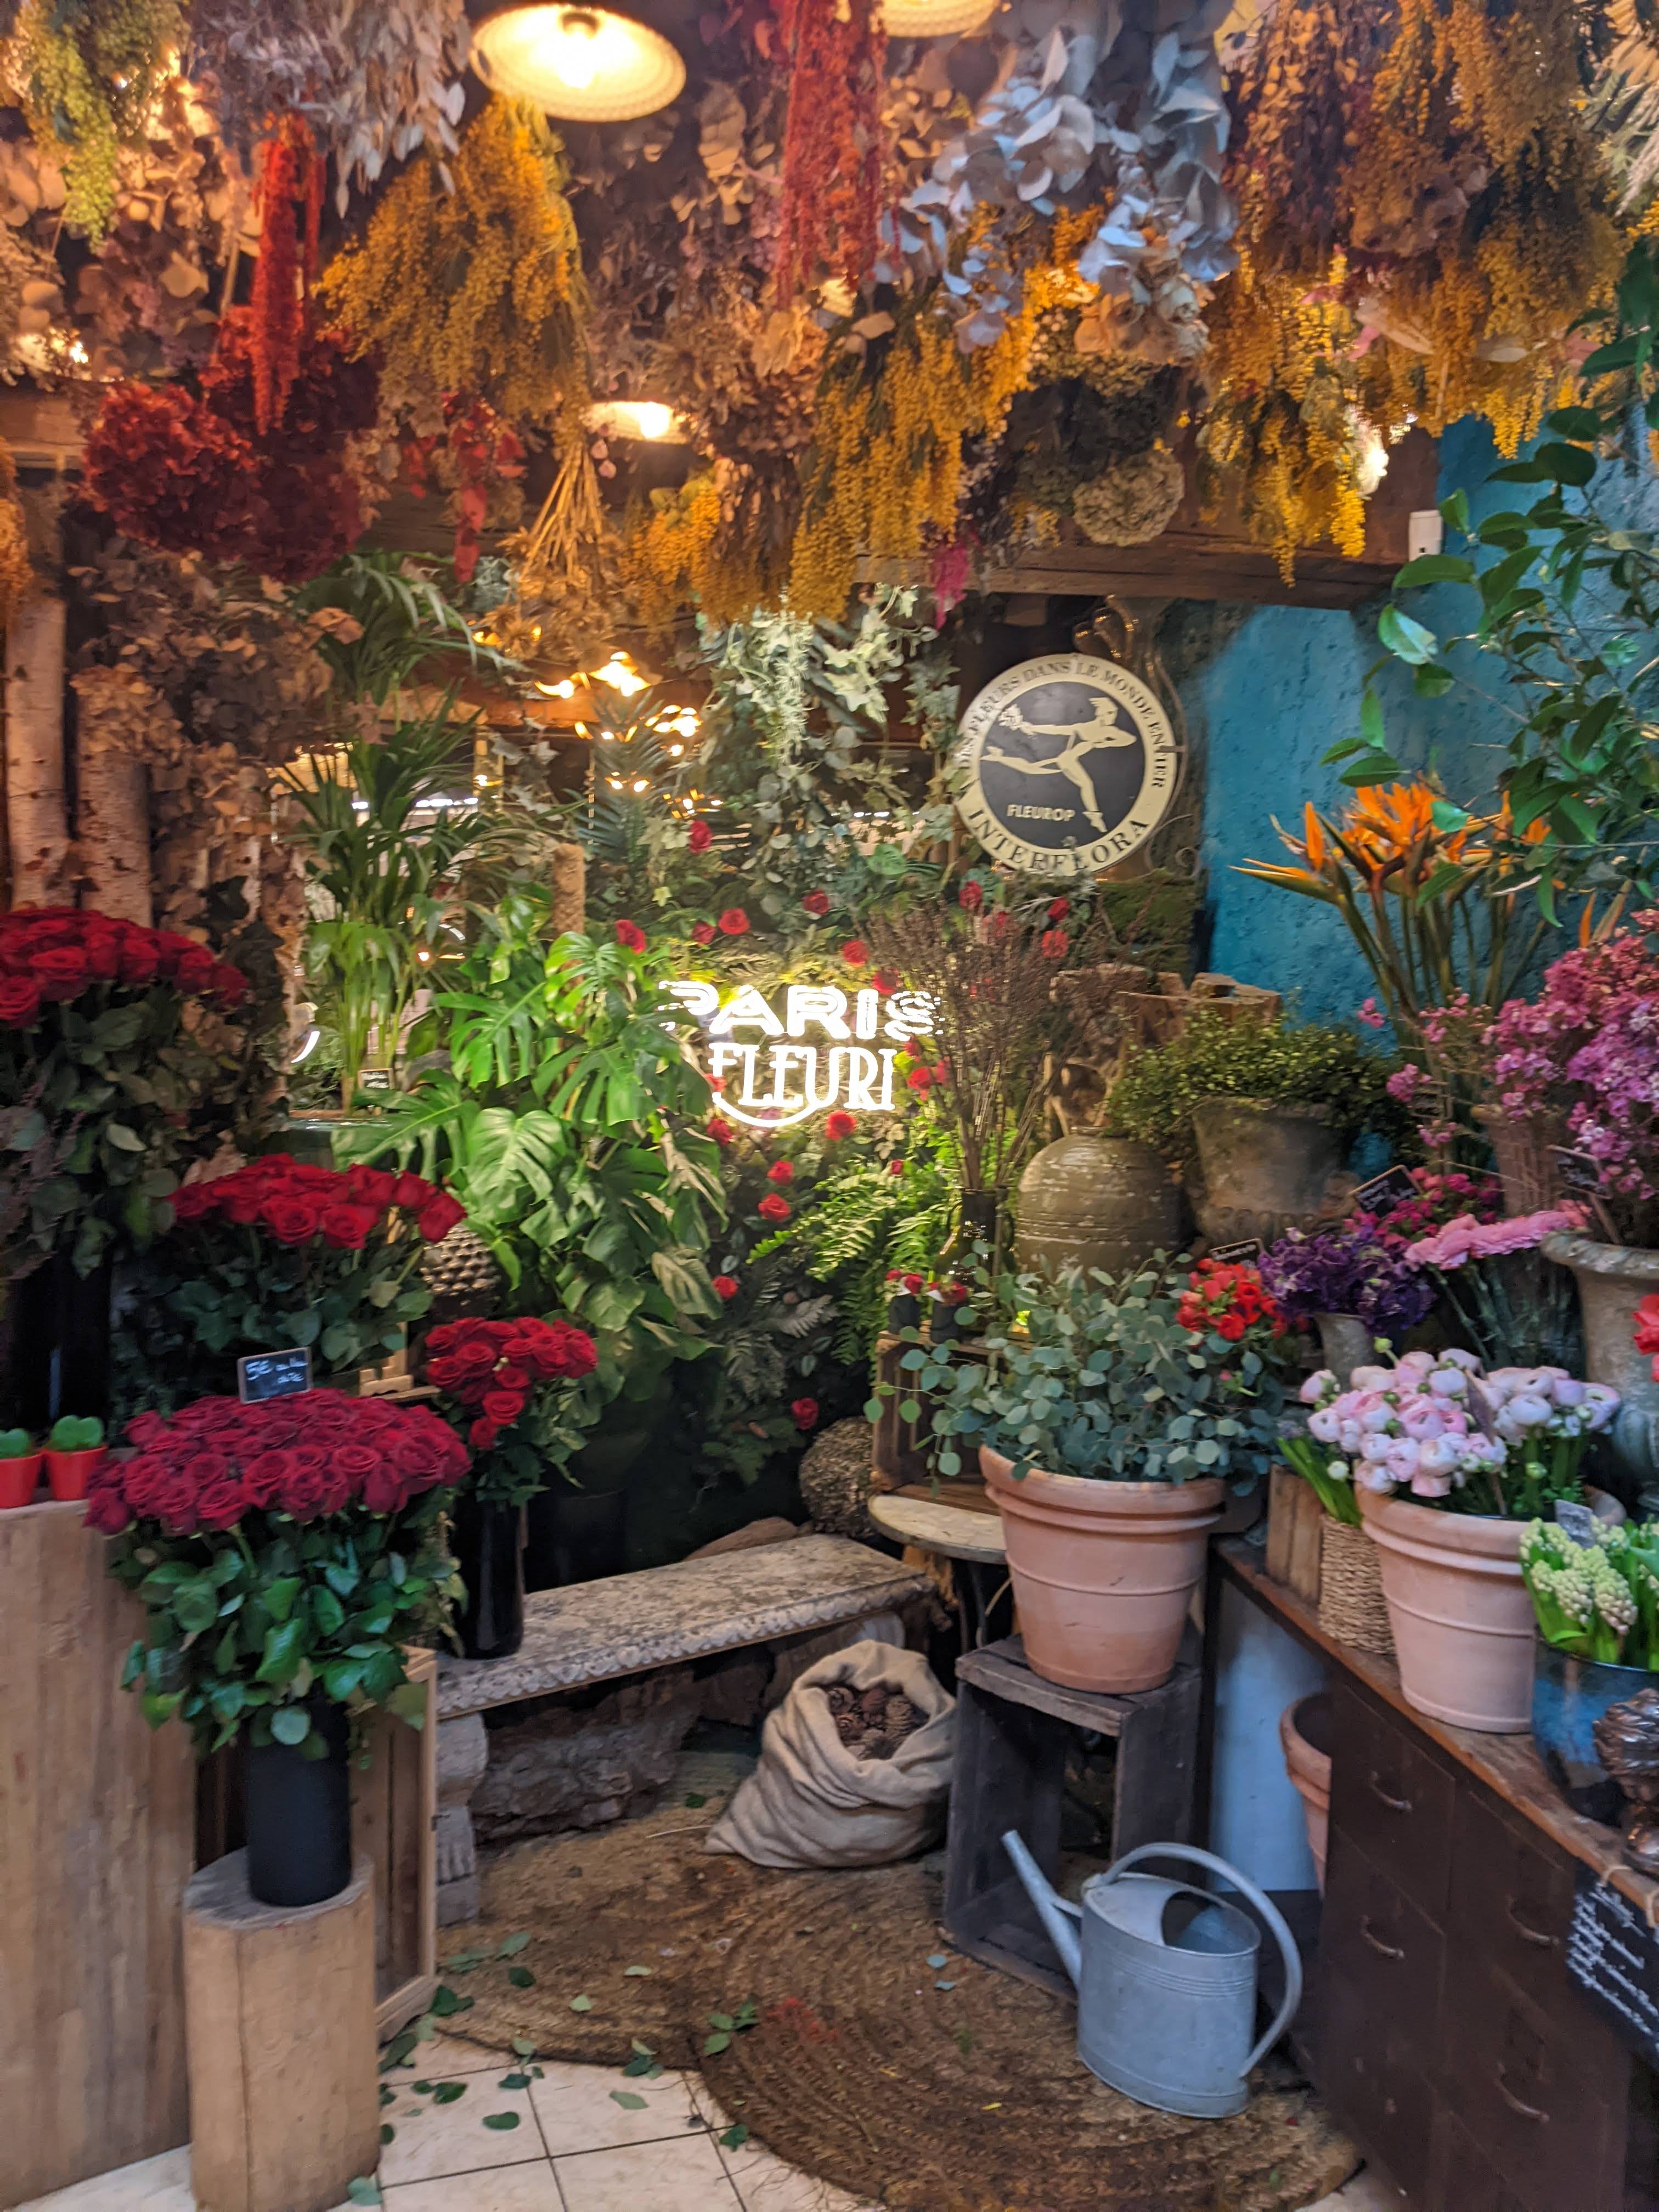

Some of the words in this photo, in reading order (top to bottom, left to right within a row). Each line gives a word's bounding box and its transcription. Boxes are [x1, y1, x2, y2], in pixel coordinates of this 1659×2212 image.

[967, 676, 1019, 732] FLEURS
[1022, 662, 1071, 681] DANS
[1075, 662, 1099, 678] LE
[1100, 670, 1155, 720] MONDE
[1148, 721, 1167, 788] ENTIER
[968, 809, 1149, 871] INTERFLORA
[1007, 804, 1075, 821] FLEUROP
[658, 980, 943, 1041] PARIS
[708, 1043, 898, 1127] FLEURI
